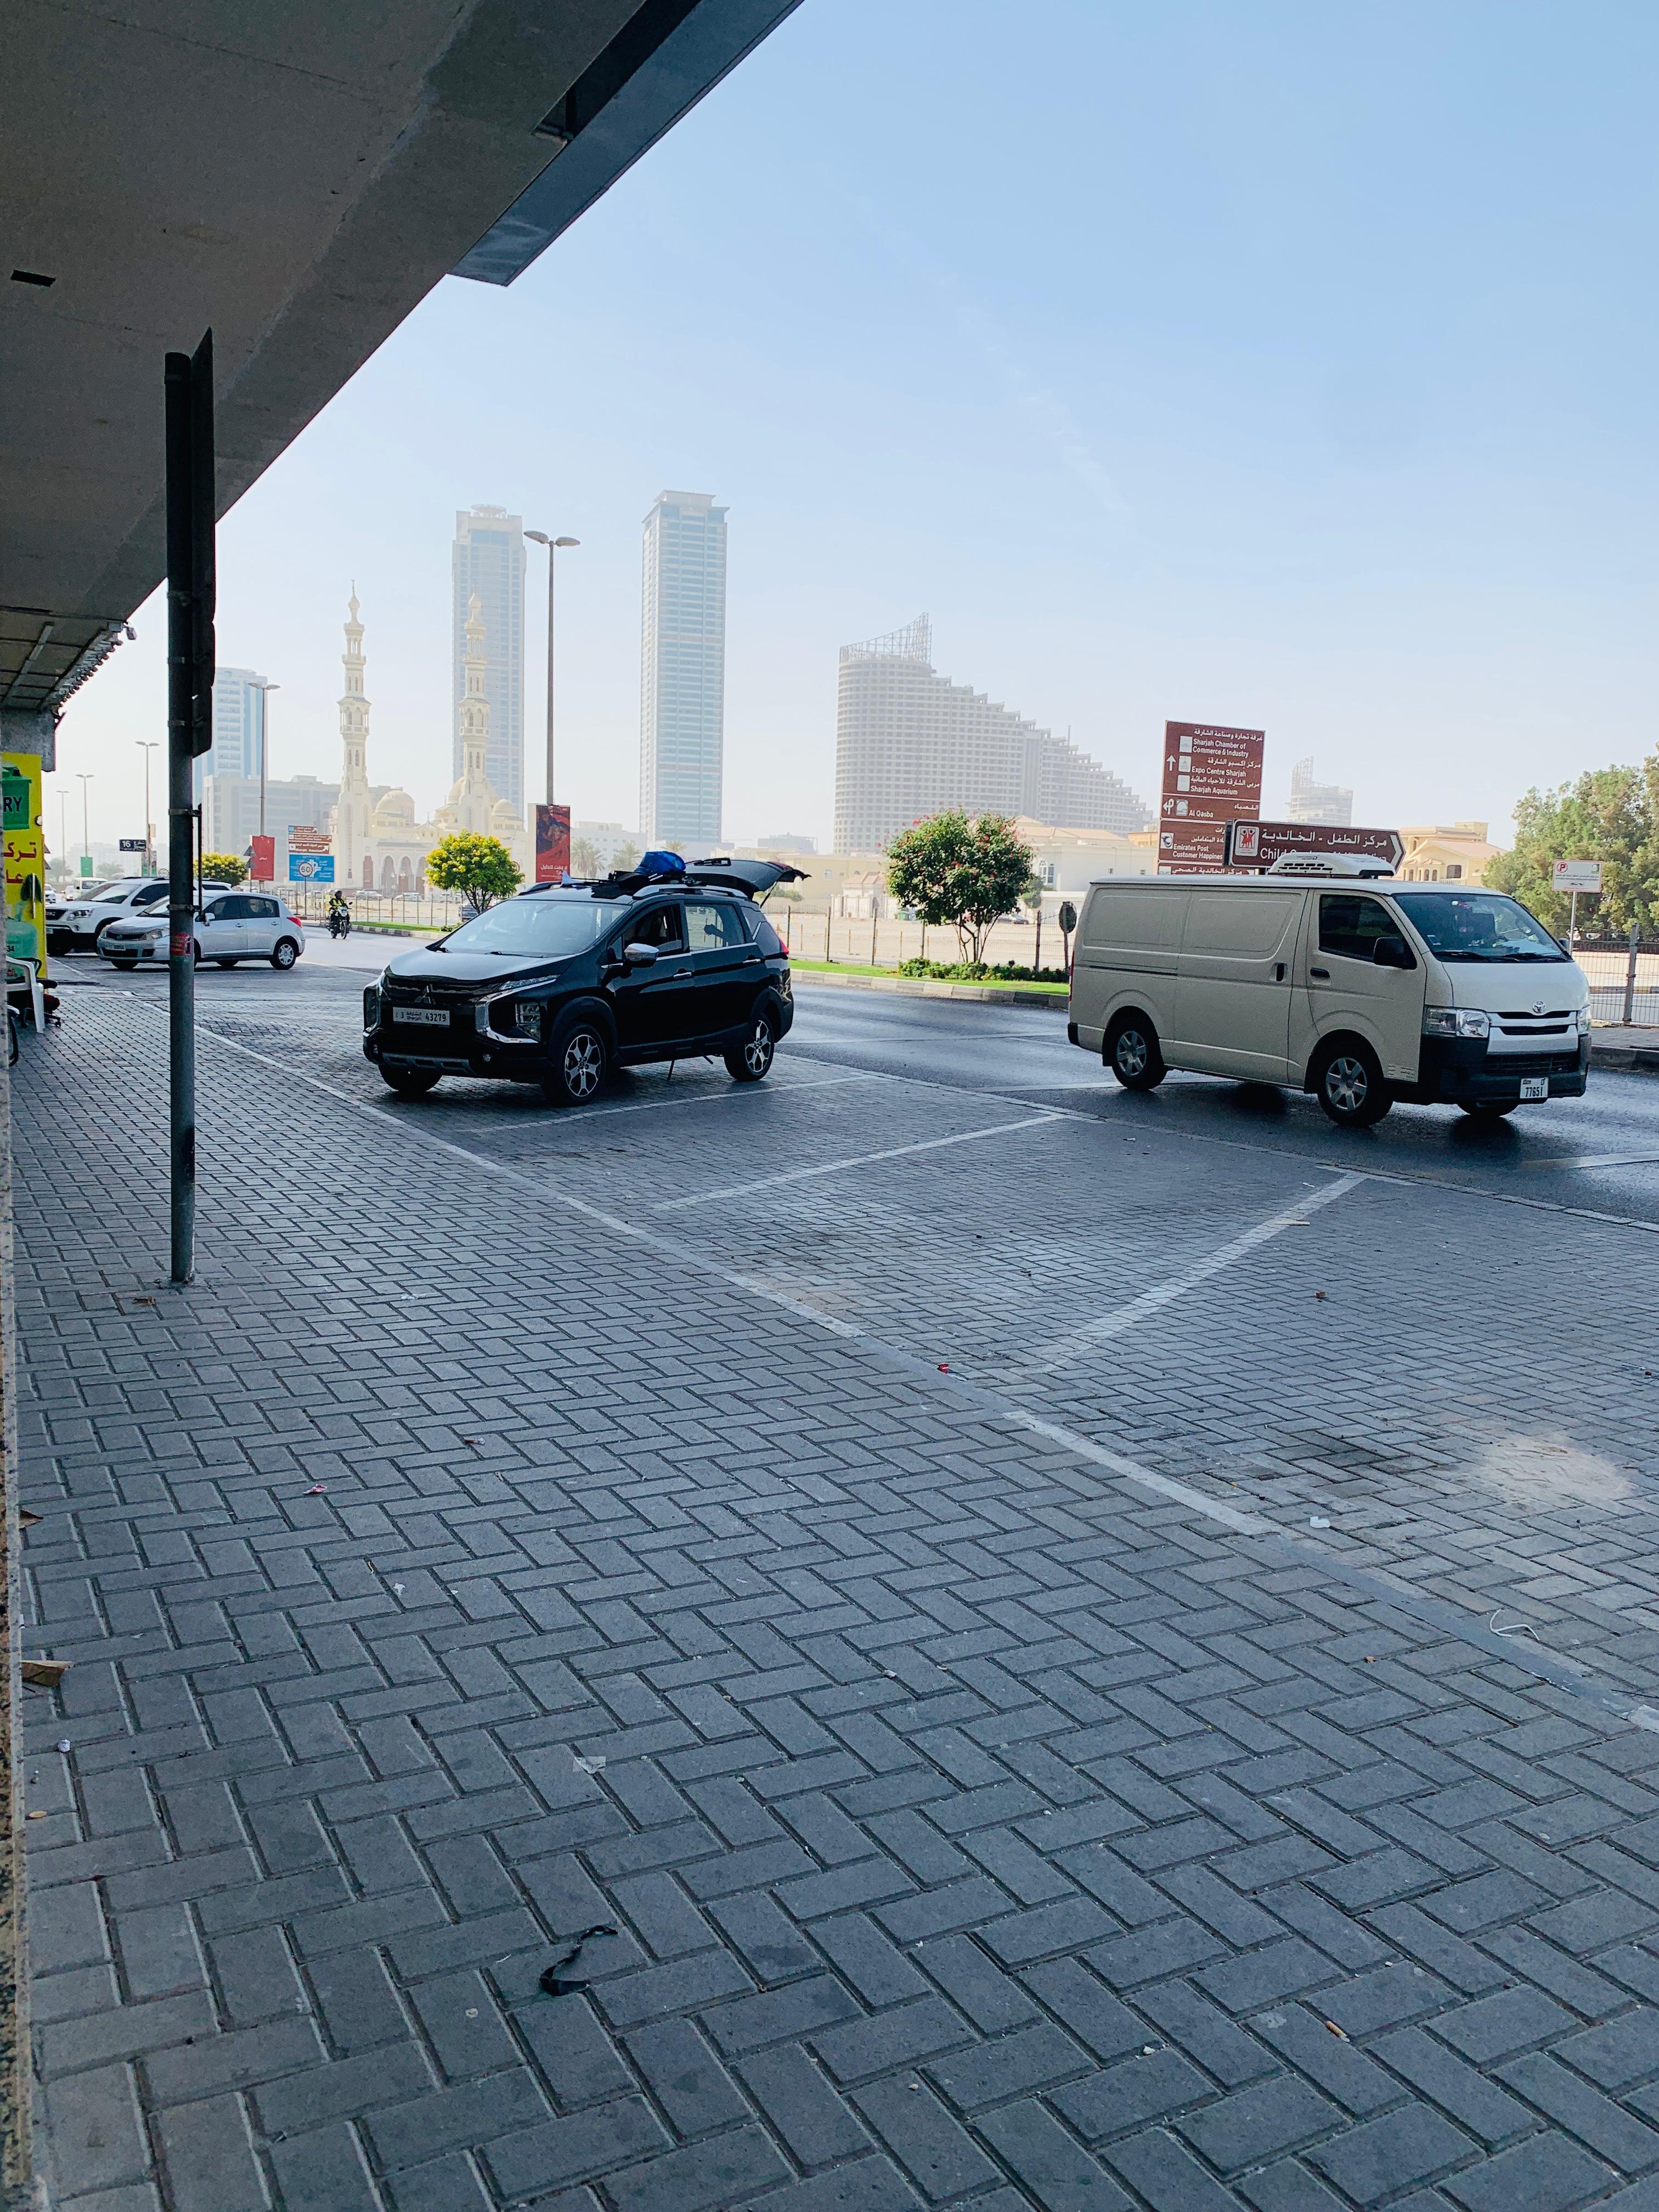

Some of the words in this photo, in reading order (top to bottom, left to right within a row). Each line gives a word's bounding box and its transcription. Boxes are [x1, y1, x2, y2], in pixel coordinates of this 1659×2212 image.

[1215, 730, 1234, 740] وصناعة
[1193, 738, 1214, 747] Sharjah
[1215, 740, 1239, 749] Chamber
[1193, 746, 1222, 755] Commerce
[1227, 749, 1249, 758] Industry
[1207, 757, 1227, 765] الشارقة
[1226, 769, 1246, 777] Sharjah
[1227, 778, 1246, 787] الشارقة
[1212, 787, 1238, 795] Aquarium
[1262, 830, 1315, 842] الخالدية
[1327, 833, 1360, 845] الطفل
[1363, 835, 1387, 848] مركز
[425, 1013, 446, 1022] 43279
[1525, 1086, 1543, 1097] 77651
